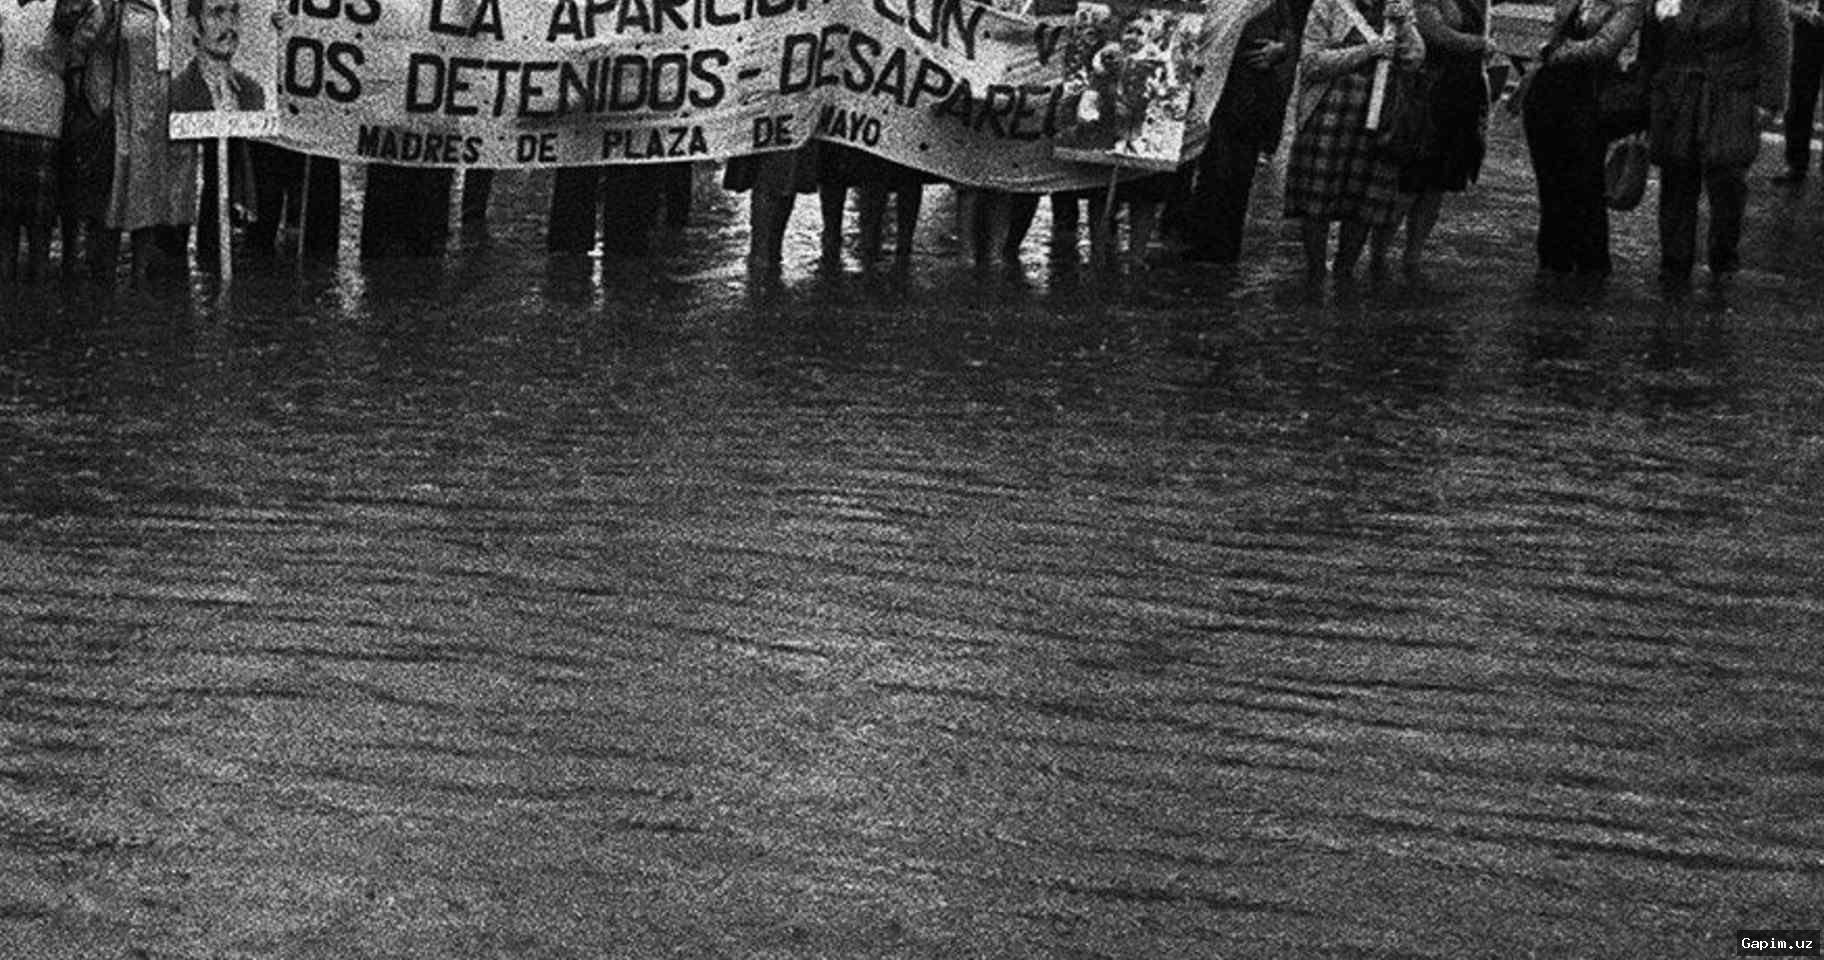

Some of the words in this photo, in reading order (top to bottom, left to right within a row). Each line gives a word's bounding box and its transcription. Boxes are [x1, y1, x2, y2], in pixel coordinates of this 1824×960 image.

[277, 36, 365, 103] OS
[406, 48, 730, 117] DETENIDOS
[358, 124, 484, 163] MADRES
[517, 133, 560, 163] DE
[603, 125, 709, 159] PLAZA
[753, 113, 794, 148] DE
